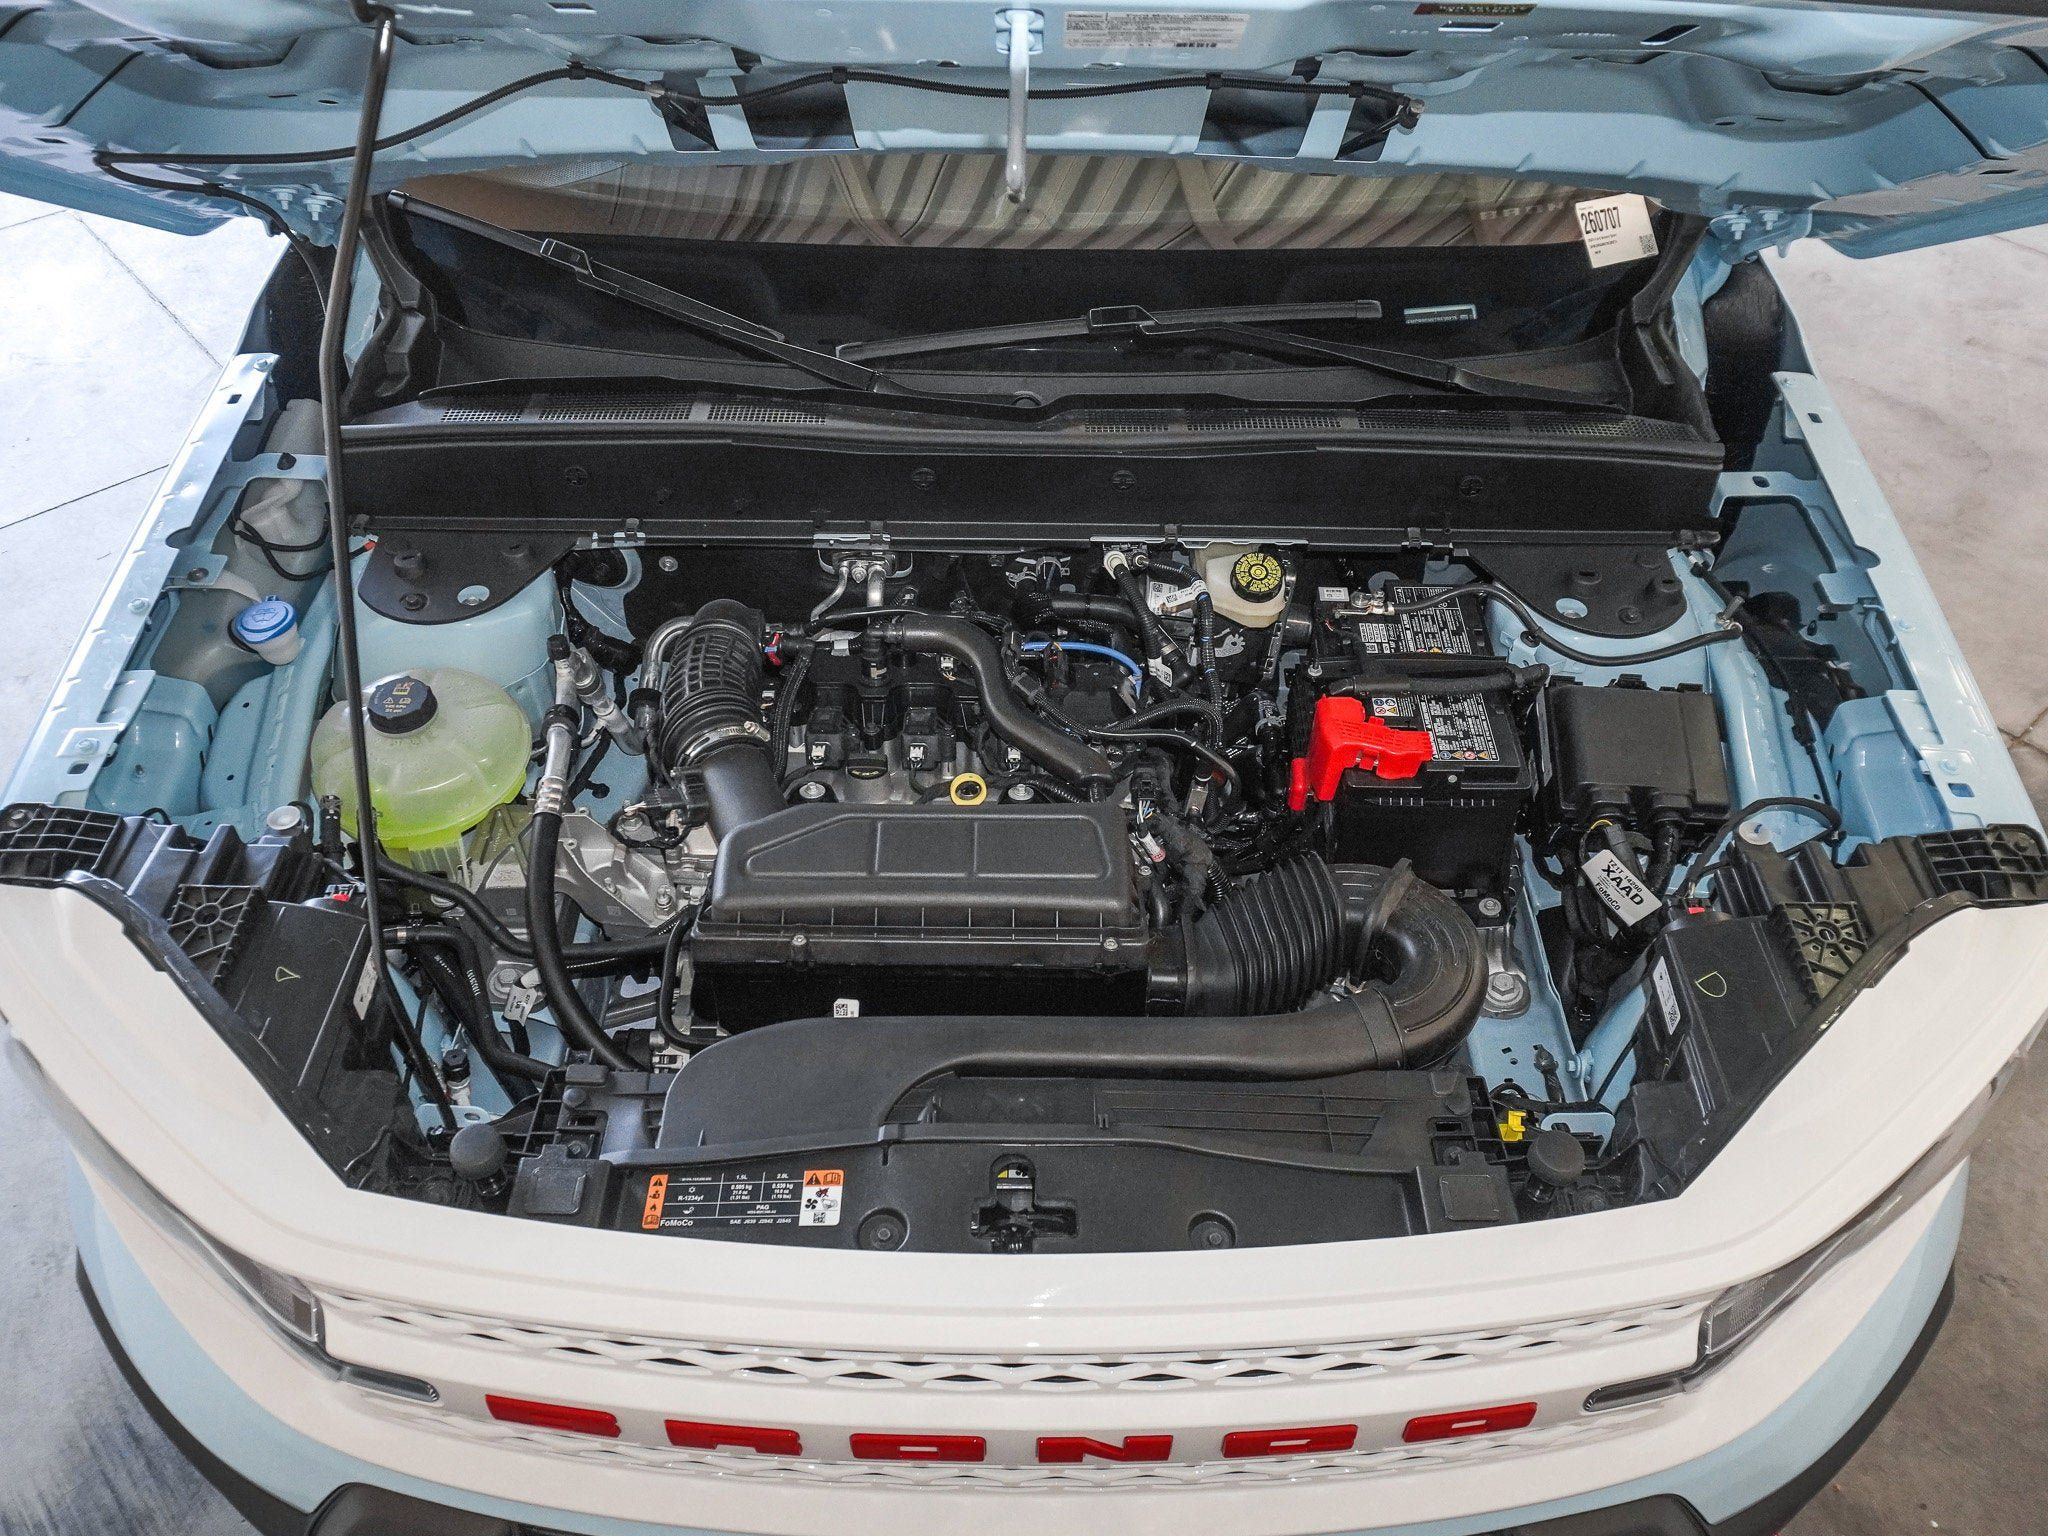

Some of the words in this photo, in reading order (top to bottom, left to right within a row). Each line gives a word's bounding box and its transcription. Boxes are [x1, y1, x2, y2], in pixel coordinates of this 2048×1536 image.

[1581, 207, 1621, 235] 260707
[1595, 882, 1621, 910] FoMoCo
[1601, 864, 1644, 905] XAAD
[1624, 875, 1643, 893] 14290
[660, 1219, 694, 1227] FoMoCo
